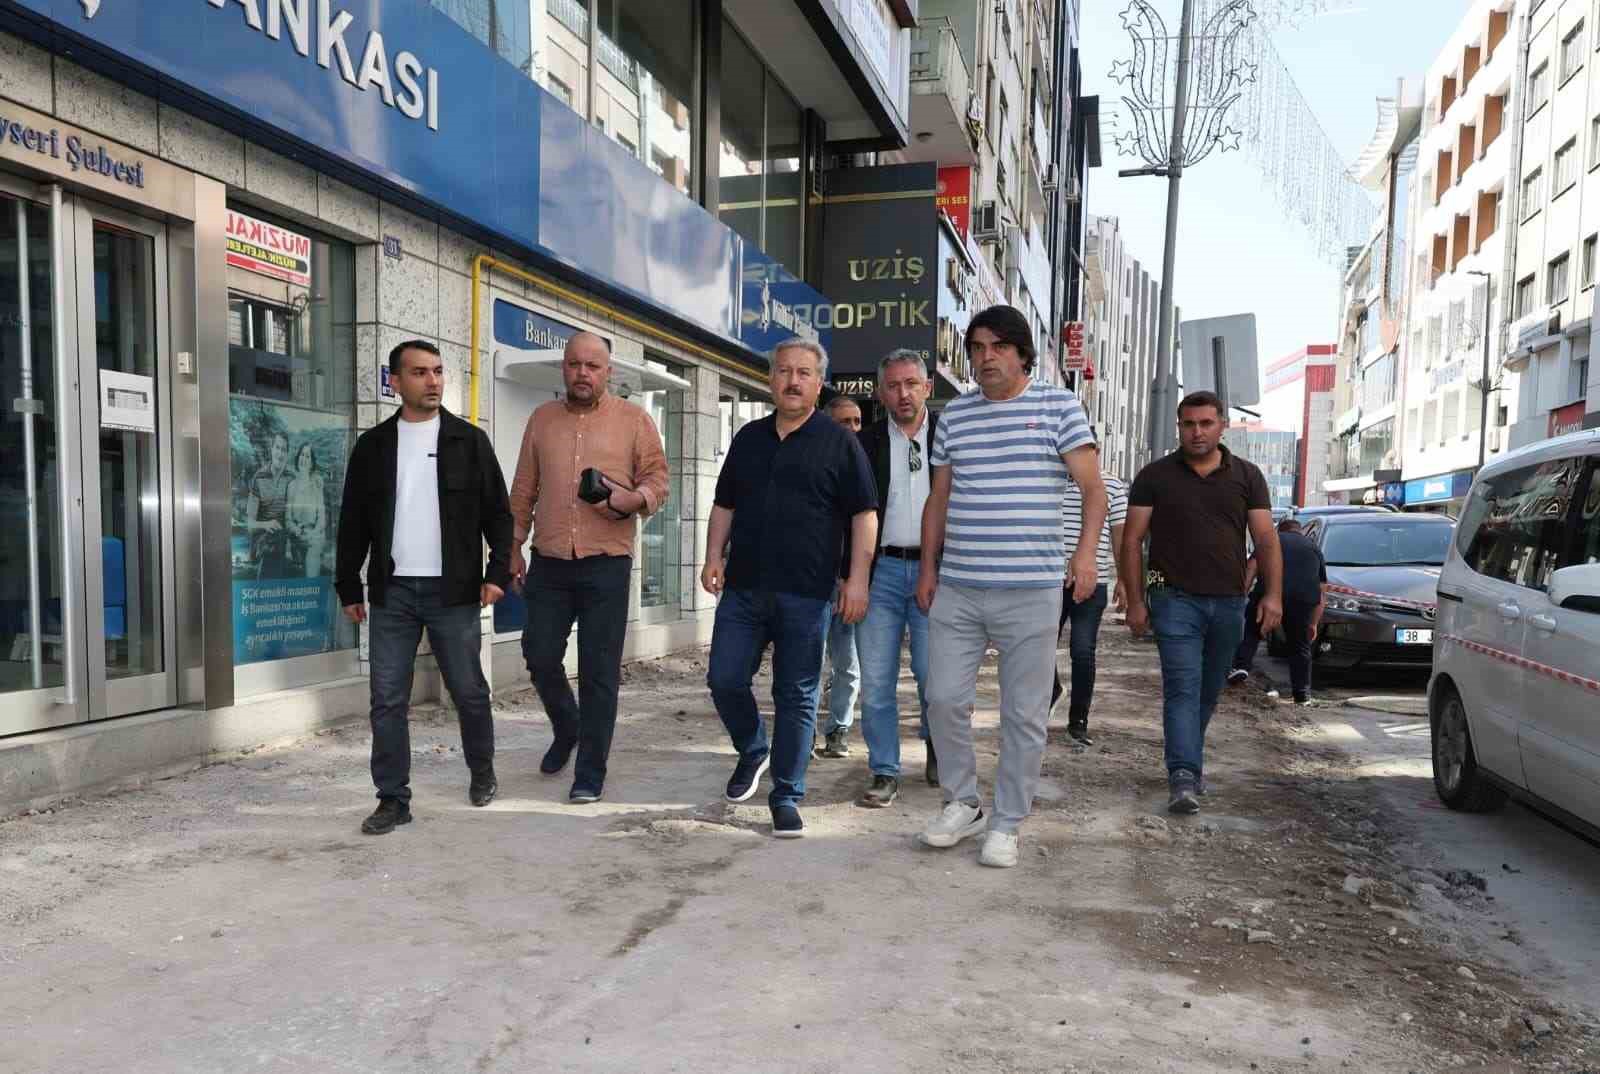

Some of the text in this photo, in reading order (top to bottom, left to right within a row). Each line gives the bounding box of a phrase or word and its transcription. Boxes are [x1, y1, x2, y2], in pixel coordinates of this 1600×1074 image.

[206, 0, 437, 131] NKASI
[65, 134, 145, 188] Şubesi
[848, 249, 926, 285] UZİŞ
[833, 293, 931, 329] OPTİK
[1406, 631, 1417, 641] 38
